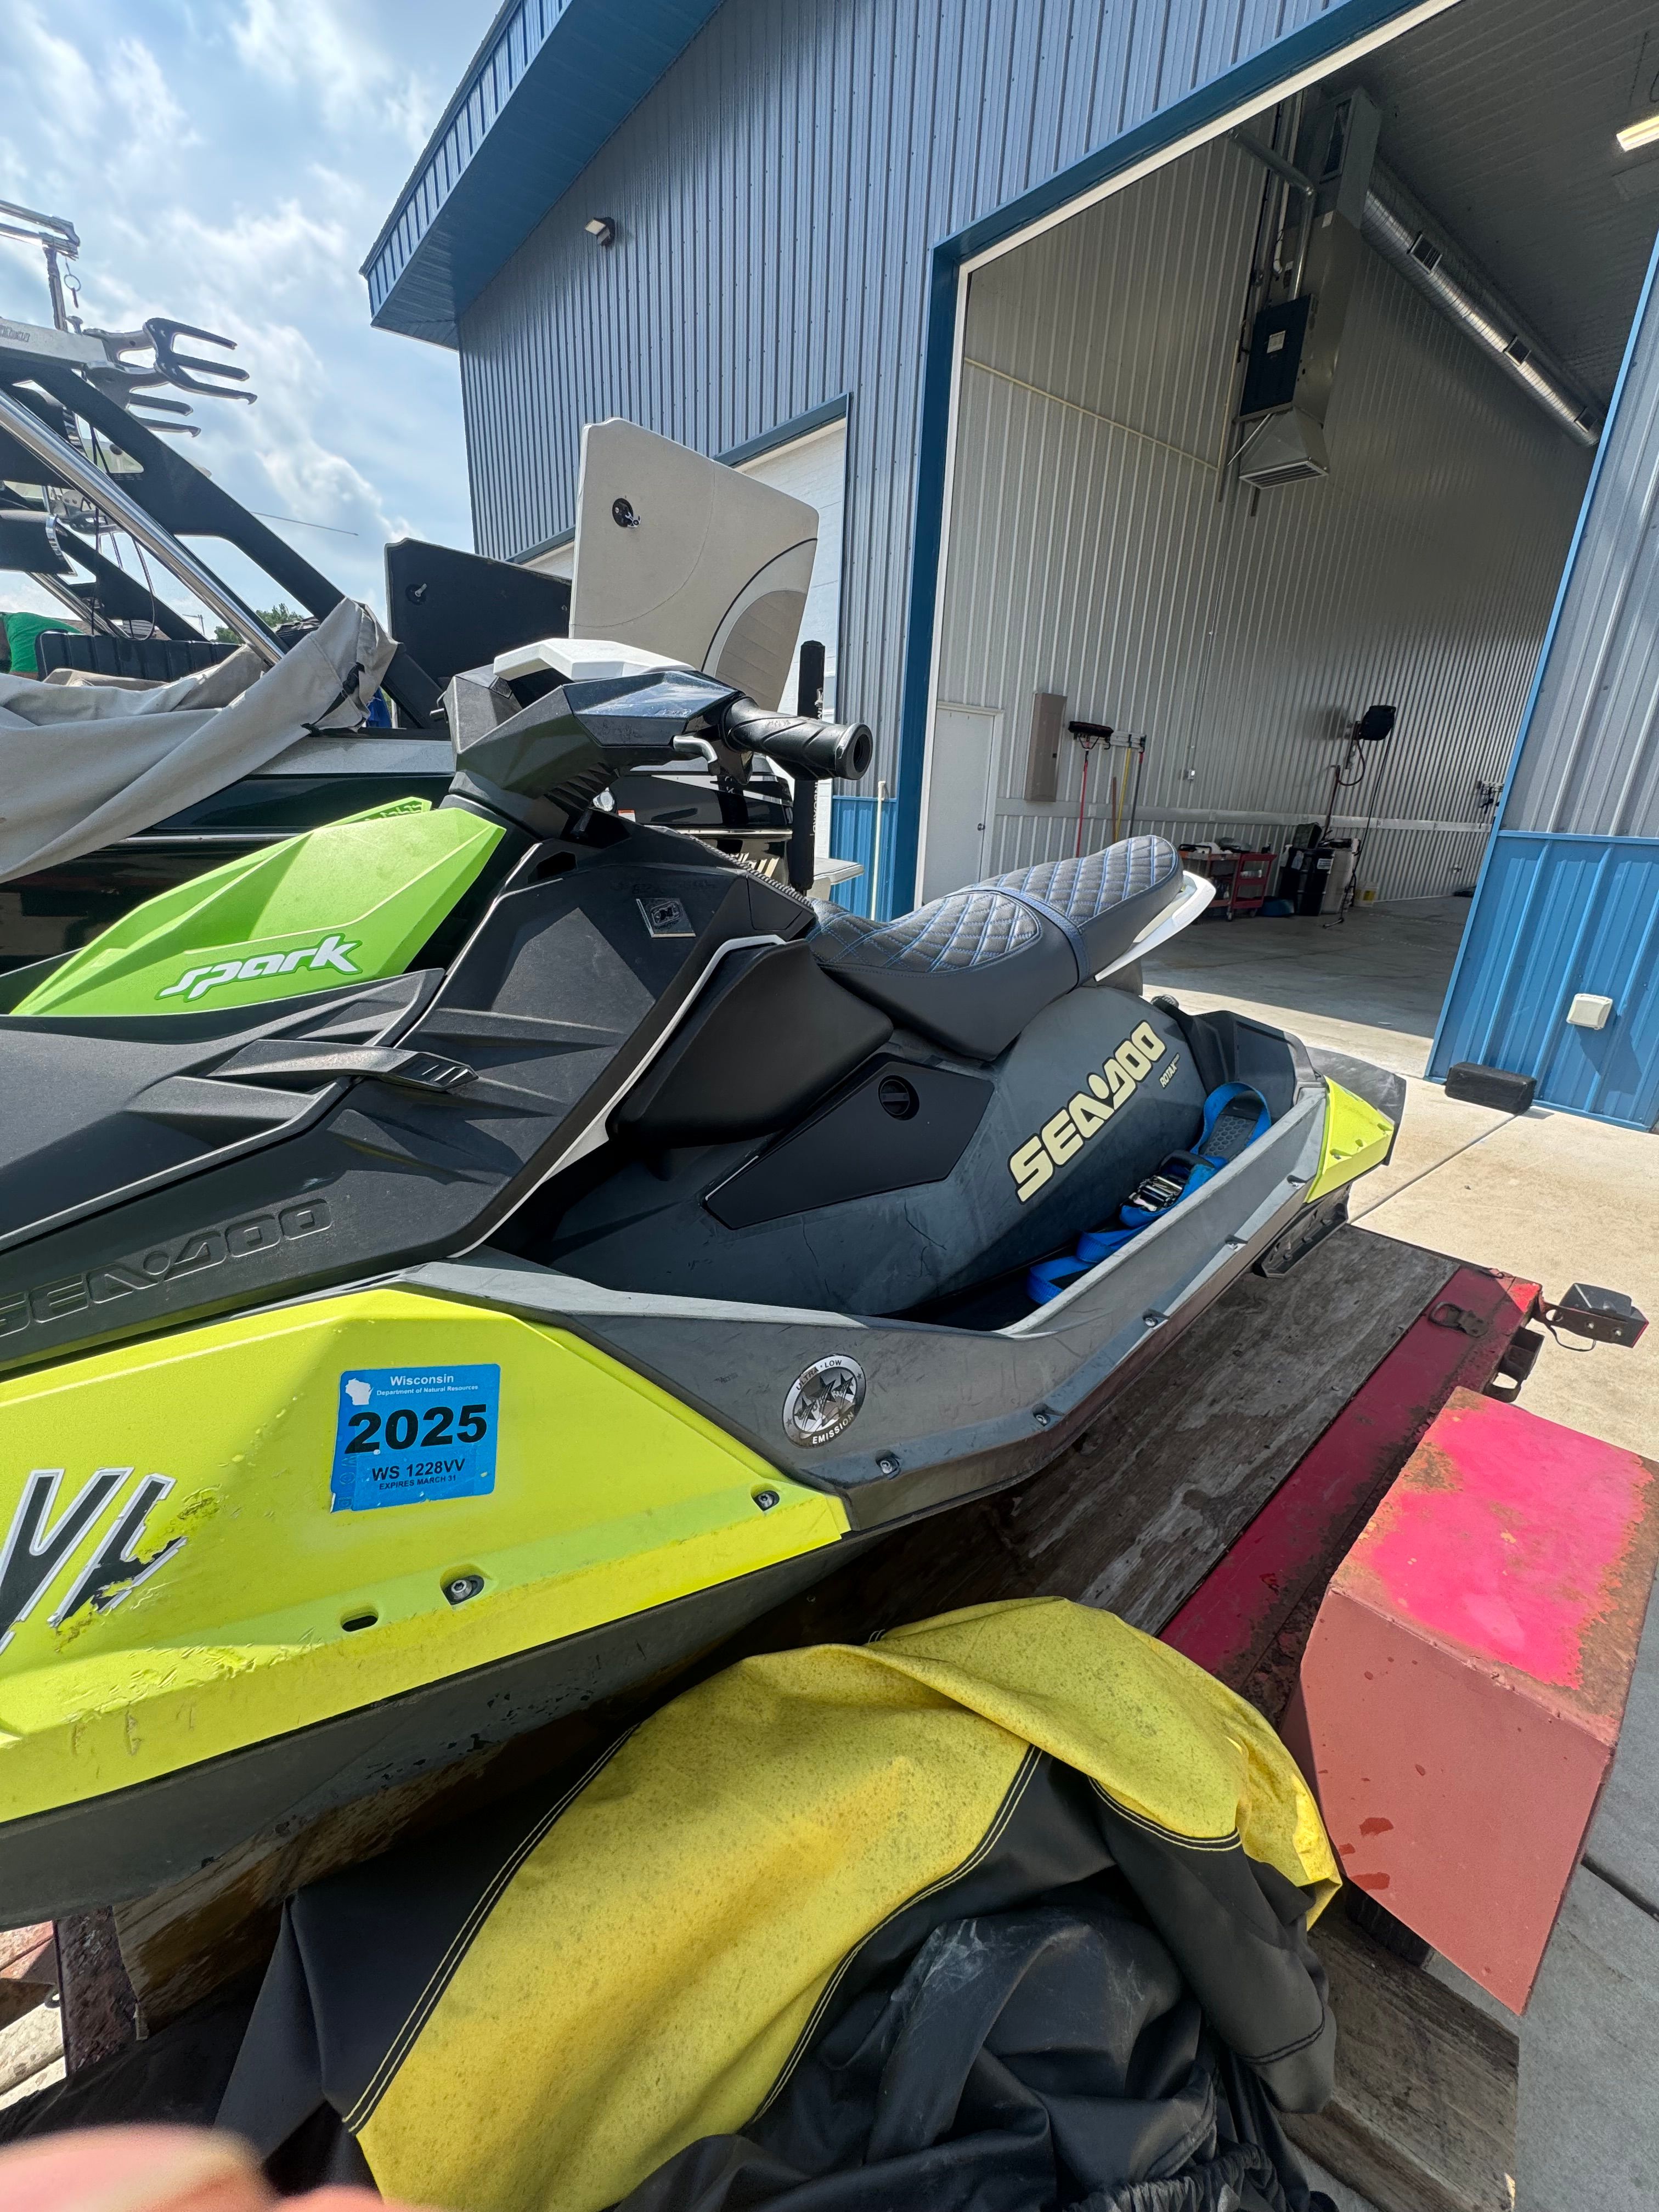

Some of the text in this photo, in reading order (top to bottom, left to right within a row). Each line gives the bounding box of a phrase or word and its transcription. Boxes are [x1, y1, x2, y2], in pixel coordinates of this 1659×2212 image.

[1159, 1063, 1177, 1088] ROTAX
[390, 1374, 454, 1386] Wisconsin
[796, 1359, 842, 1391] ULTRA LOW
[344, 1403, 487, 1454] 2025
[811, 1410, 855, 1444] EMISSION
[371, 1458, 466, 1481] WS 1228VV
[379, 1480, 415, 1490] EXPIRES
[416, 1476, 446, 1486] MARCH
